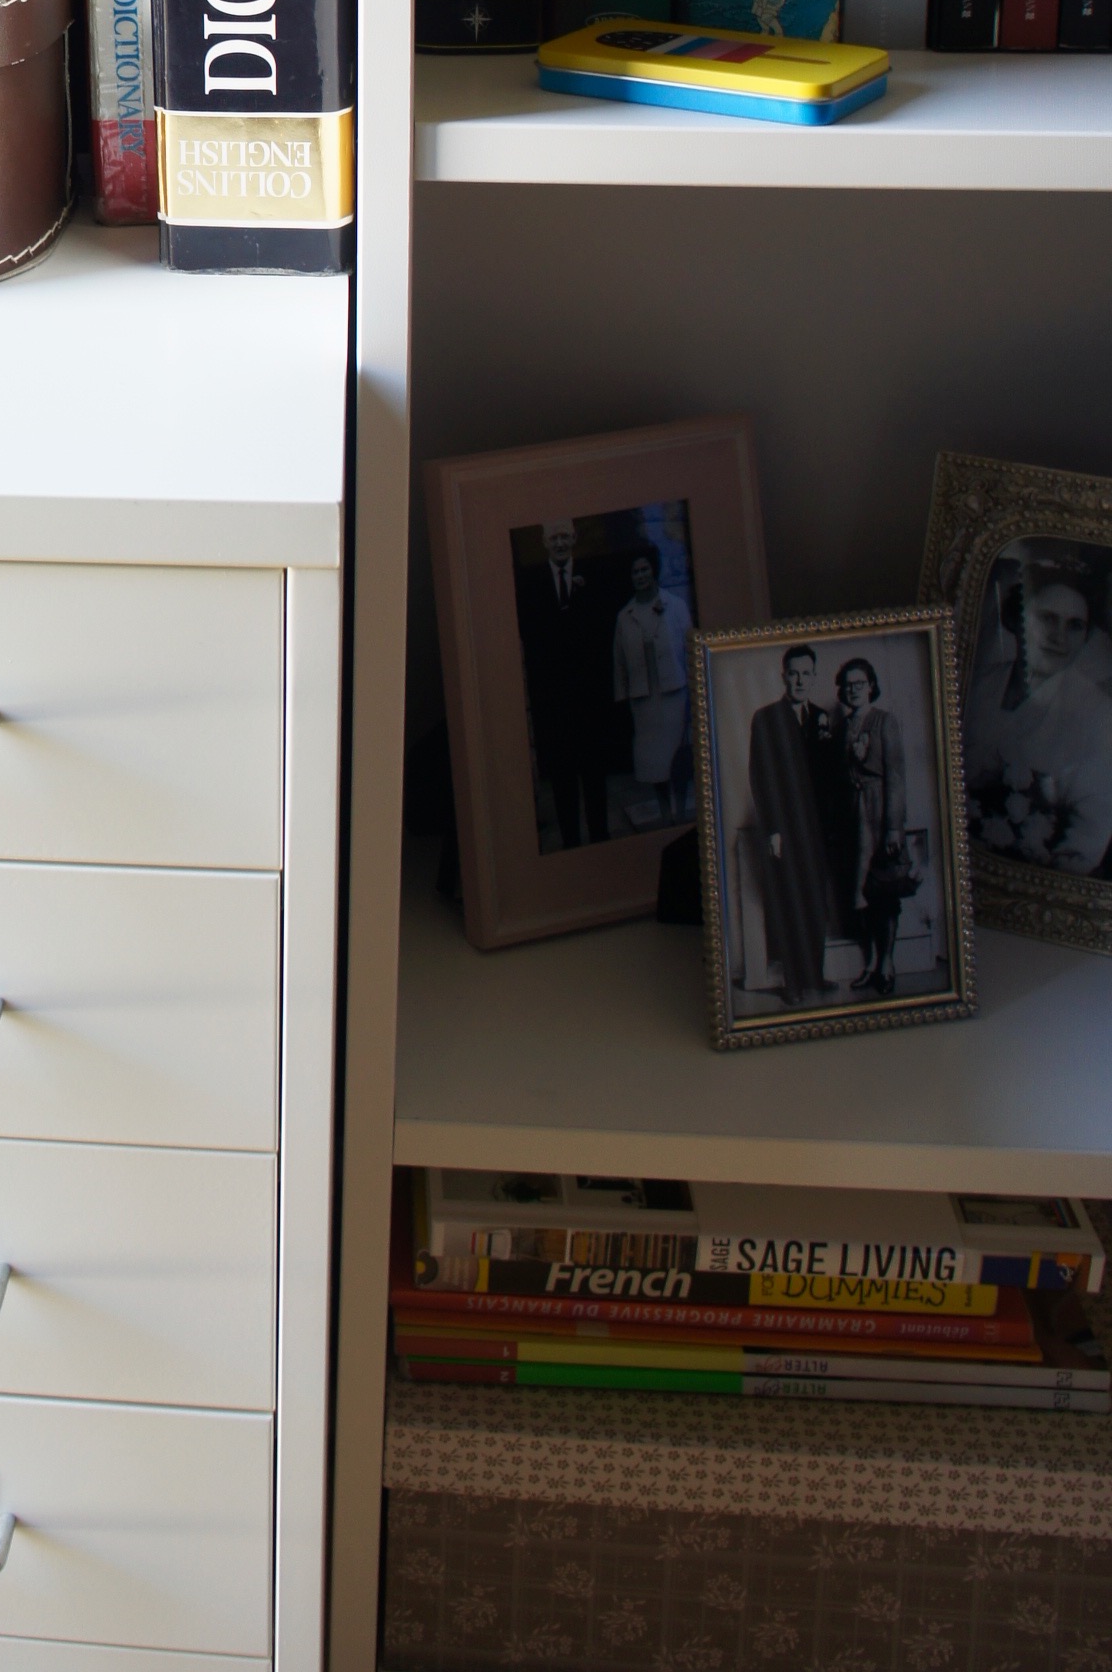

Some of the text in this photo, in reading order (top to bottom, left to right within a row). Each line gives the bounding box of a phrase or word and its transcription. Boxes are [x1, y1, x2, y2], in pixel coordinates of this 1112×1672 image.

[178, 139, 312, 168] ENGLISH
[177, 169, 312, 199] COLLINS
[710, 1237, 730, 1272] SAGE
[736, 1238, 957, 1282] SAGE LIVING
[544, 1261, 694, 1299] French
[781, 1275, 948, 1307] DUMMIES
[465, 1295, 877, 1334] GRAMMAIRE PROGRESSIVE DU FRANÇAIS
[899, 1322, 970, 1338] débutant
[502, 1345, 510, 1358] 1
[499, 1370, 509, 1382] 2
